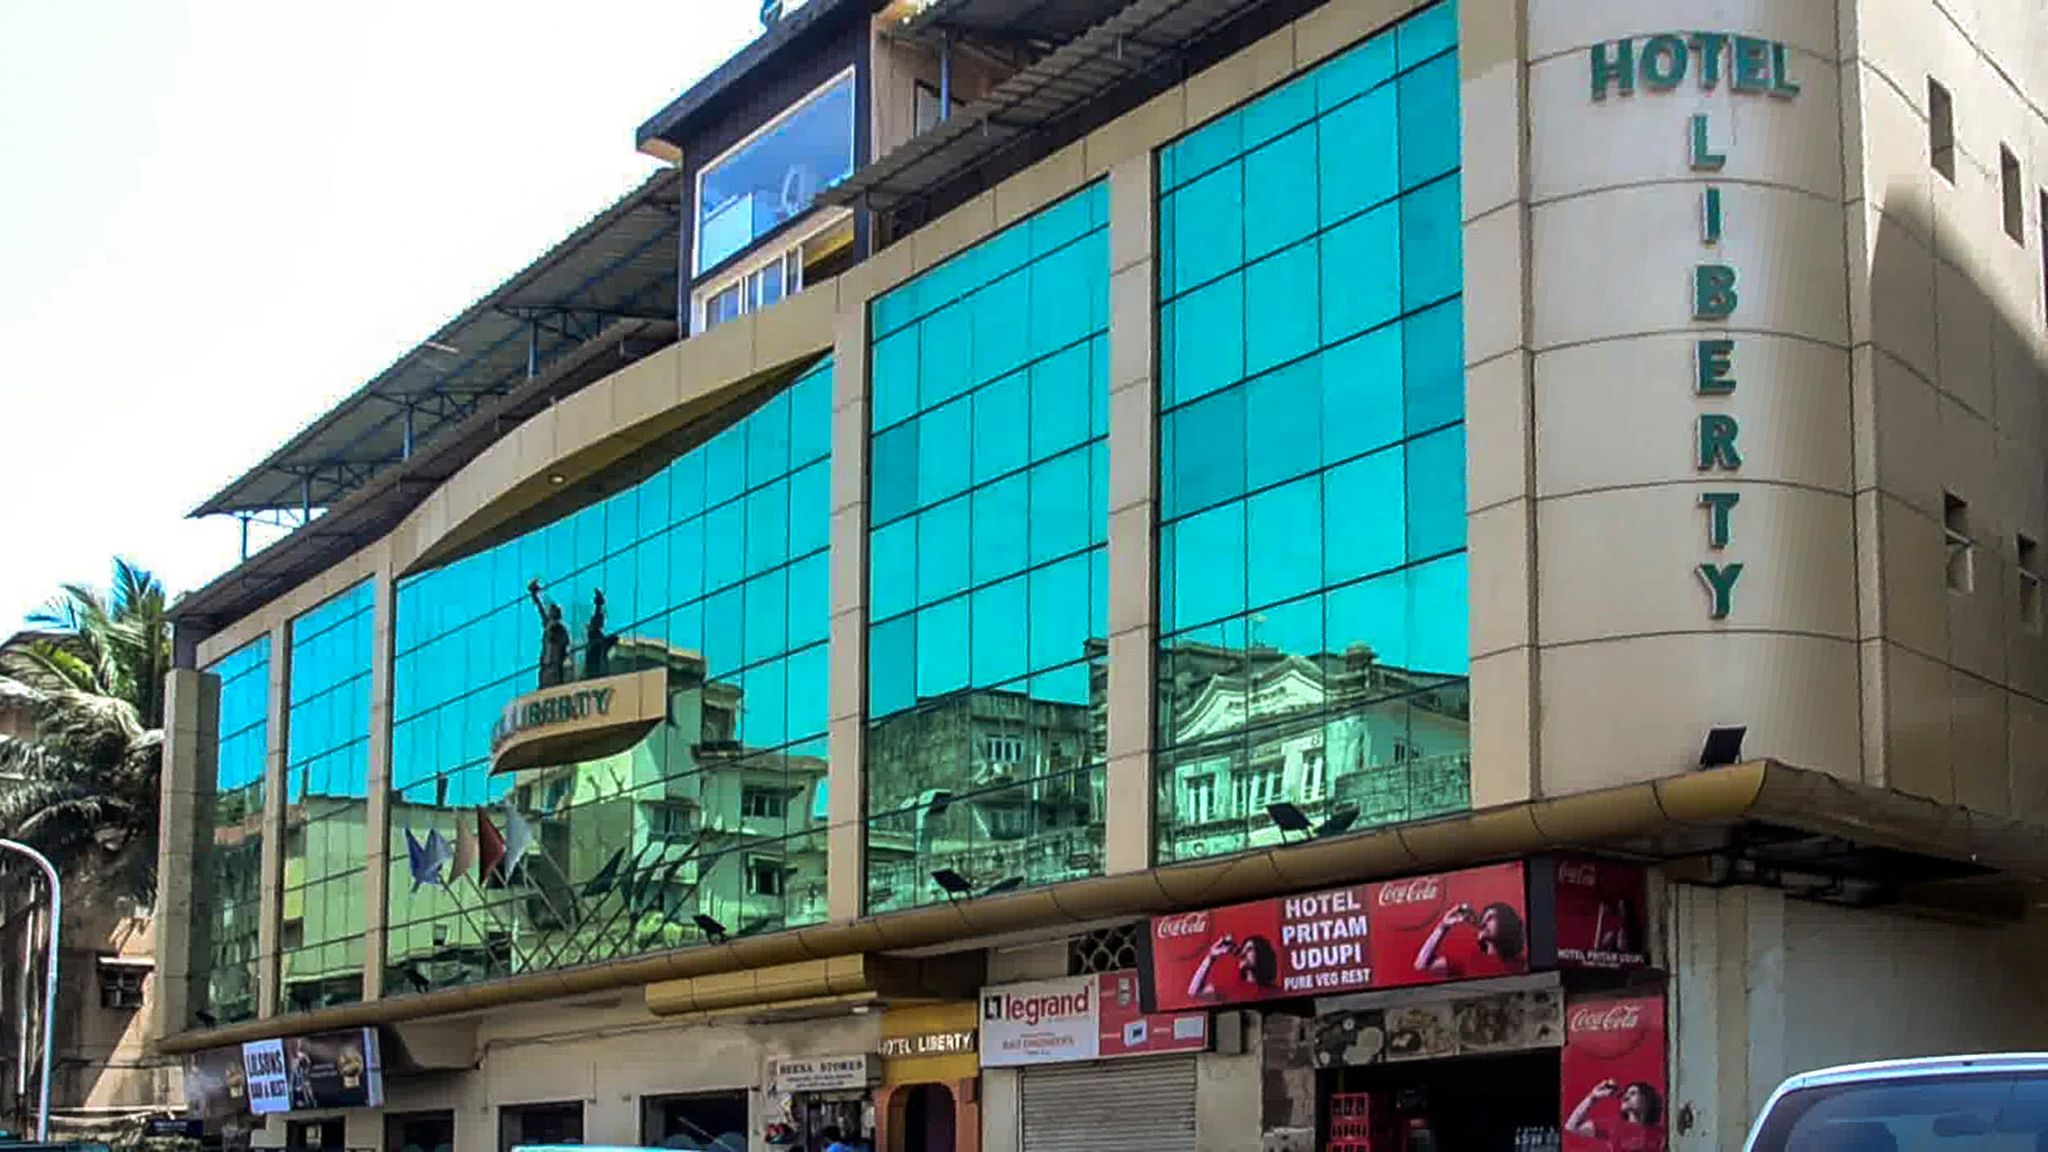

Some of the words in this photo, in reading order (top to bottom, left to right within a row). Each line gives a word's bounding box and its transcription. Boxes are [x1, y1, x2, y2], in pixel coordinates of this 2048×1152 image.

[1590, 31, 1800, 101] HOTEL
[1690, 113, 1743, 620] LIBERTY
[1285, 890, 1361, 919] HOTEL
[1282, 915, 1367, 945] PRITAM
[1291, 942, 1361, 971] UDUPI
[1284, 973, 1314, 992] PURE
[1315, 970, 1338, 987] VEG
[1341, 967, 1372, 984] REST
[1005, 985, 1089, 1026] legrand
[877, 1038, 911, 1056] HOTEL
[918, 1031, 972, 1052] LIBERTY
